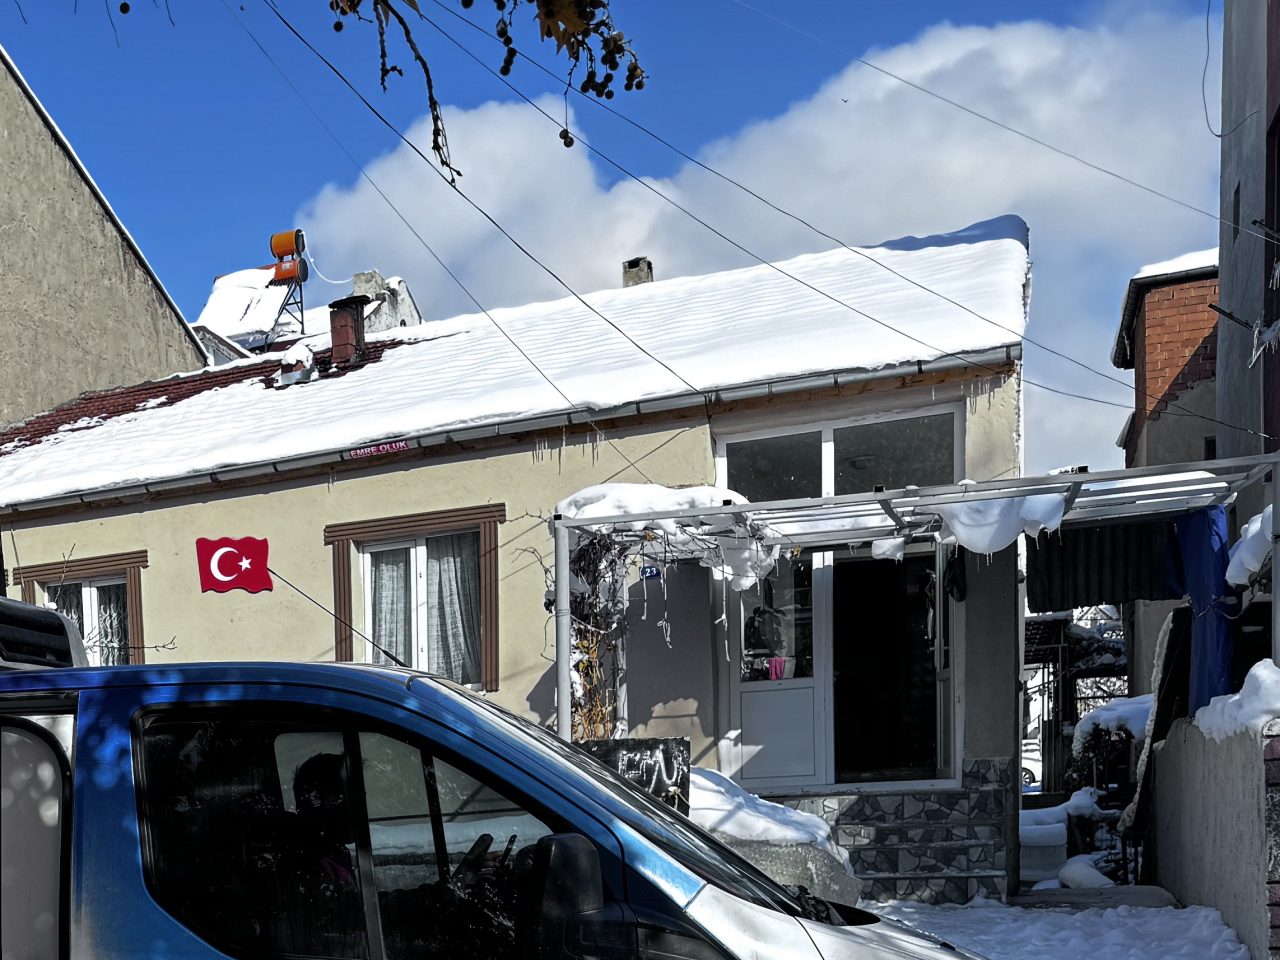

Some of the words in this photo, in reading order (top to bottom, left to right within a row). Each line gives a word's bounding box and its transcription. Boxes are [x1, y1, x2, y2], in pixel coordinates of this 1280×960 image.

[350, 446, 378, 458] EMRE
[380, 440, 407, 452] OLUK
[645, 567, 657, 577] 23
